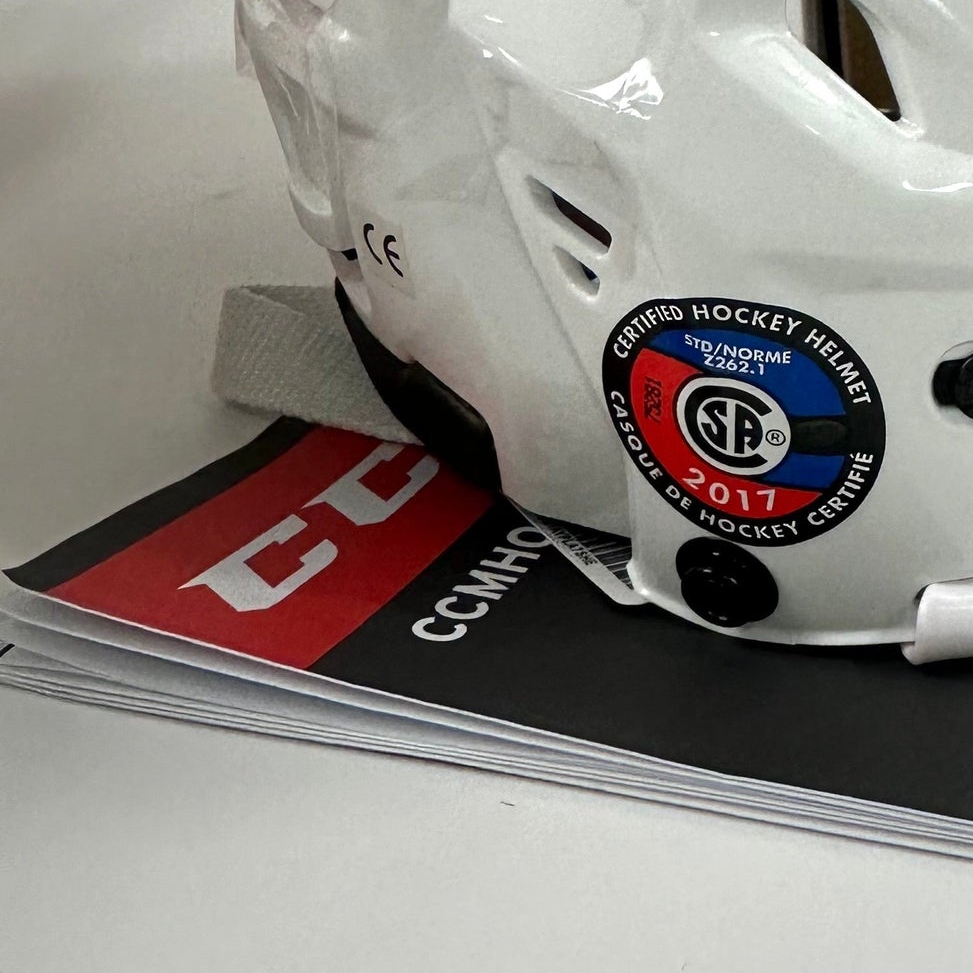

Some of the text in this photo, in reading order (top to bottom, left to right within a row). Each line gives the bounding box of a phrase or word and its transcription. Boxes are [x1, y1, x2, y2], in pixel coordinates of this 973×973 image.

[363, 222, 404, 278] CE
[613, 303, 872, 406] CERTIFIED HOCKEY HELMET
[684, 333, 792, 364] STD/NORME
[703, 353, 765, 376] Z262.1
[610, 390, 664, 480] CASQUE
[665, 486, 693, 511] DE
[700, 508, 800, 539] HOCKEY
[807, 452, 874, 526] CERTIFIÉ
[682, 467, 777, 512] 2017
